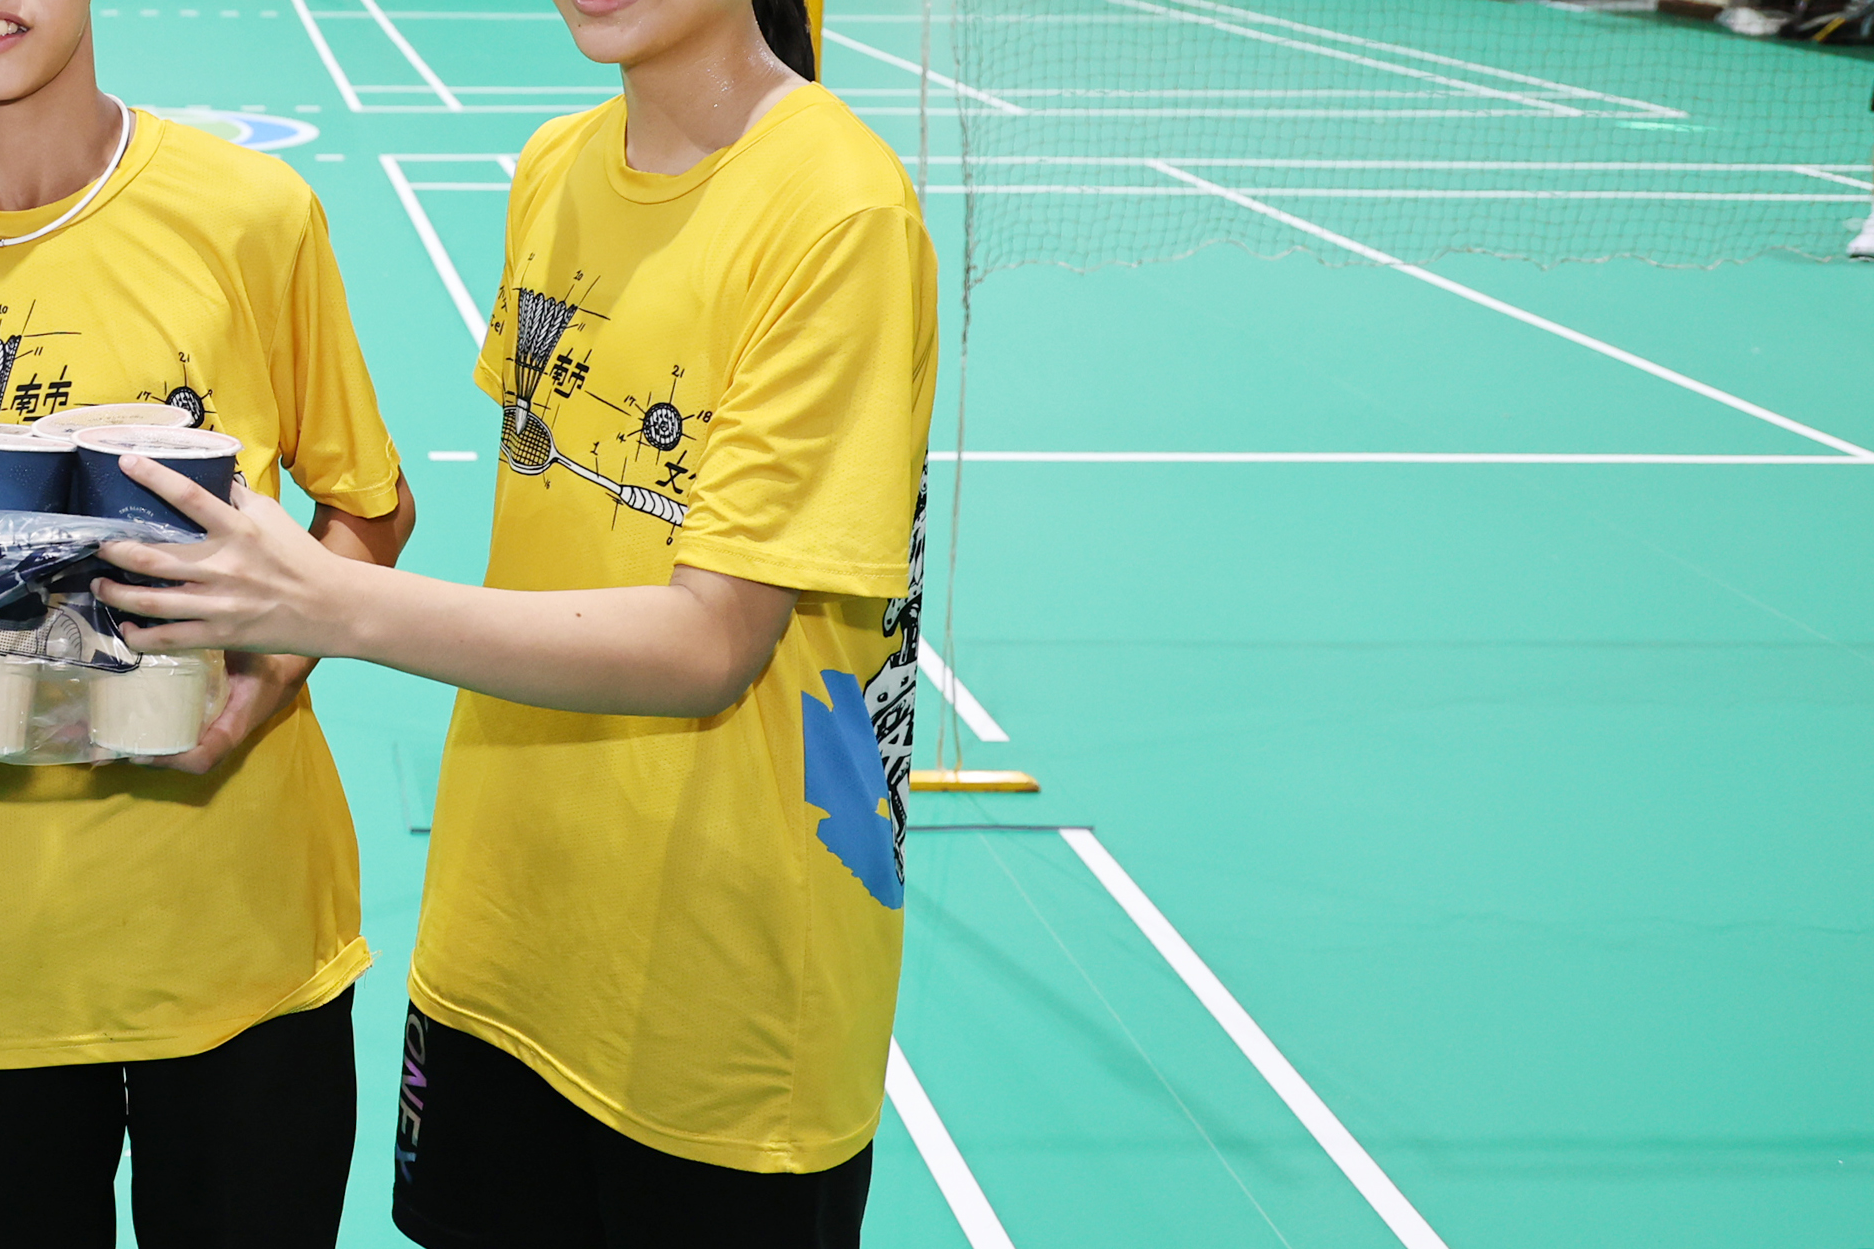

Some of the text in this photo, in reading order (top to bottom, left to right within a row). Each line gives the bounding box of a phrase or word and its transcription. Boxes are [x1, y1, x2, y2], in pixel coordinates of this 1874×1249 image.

[178, 351, 191, 363] 21
[671, 365, 685, 378] 21
[696, 410, 713, 424] 18
[395, 1013, 429, 1185] ONEX
